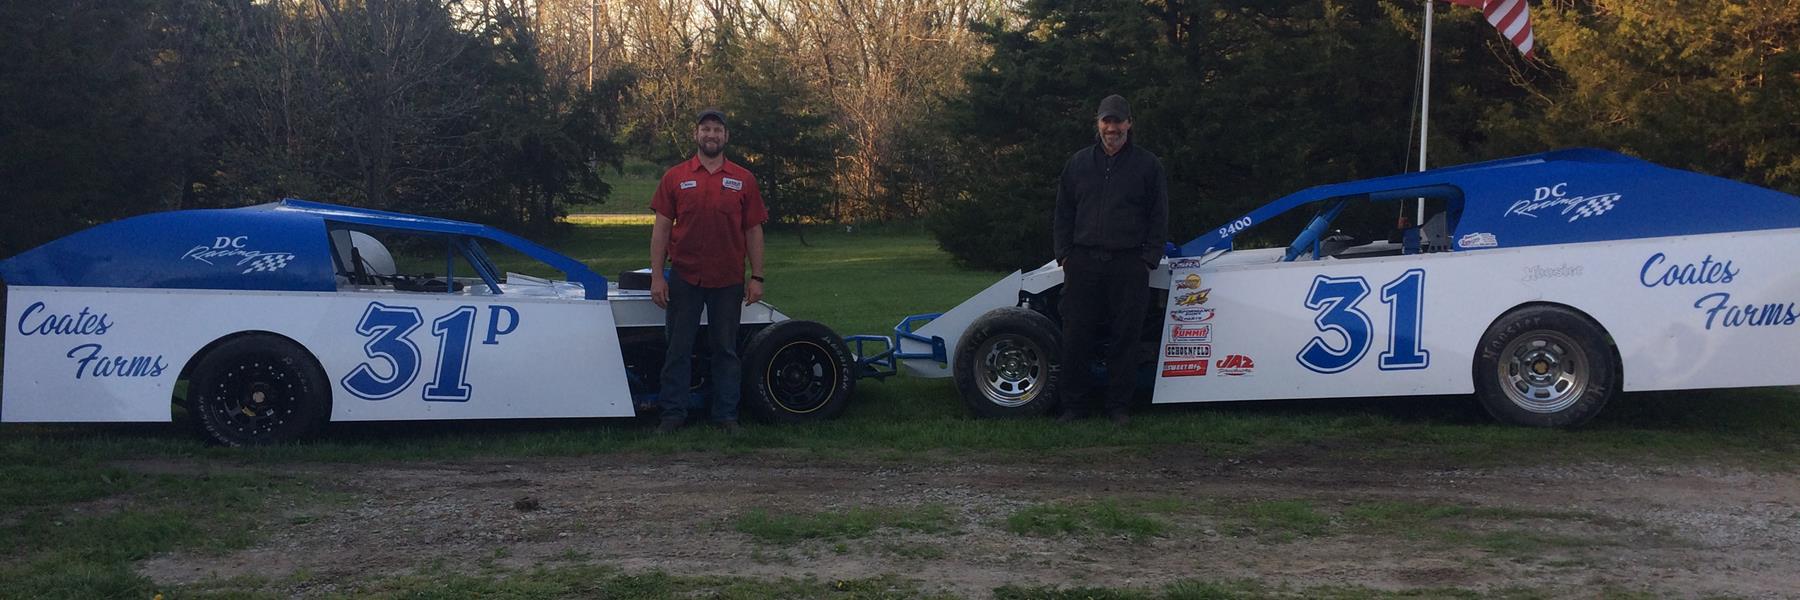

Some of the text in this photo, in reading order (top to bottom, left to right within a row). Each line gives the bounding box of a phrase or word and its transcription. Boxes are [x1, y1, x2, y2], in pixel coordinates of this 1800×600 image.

[1534, 183, 1567, 201] DC
[1504, 194, 1602, 217] Racing
[1219, 216, 1252, 238] 2400
[213, 236, 248, 249] DC
[181, 246, 277, 266] Racing
[1640, 252, 1740, 287] Coates
[18, 301, 114, 336] Coates
[1296, 268, 1430, 374] 31
[1694, 292, 1800, 330] Farms
[66, 343, 168, 379] Farms
[1167, 346, 1209, 355] SCHOENFELD
[1216, 355, 1254, 368] JAZ
